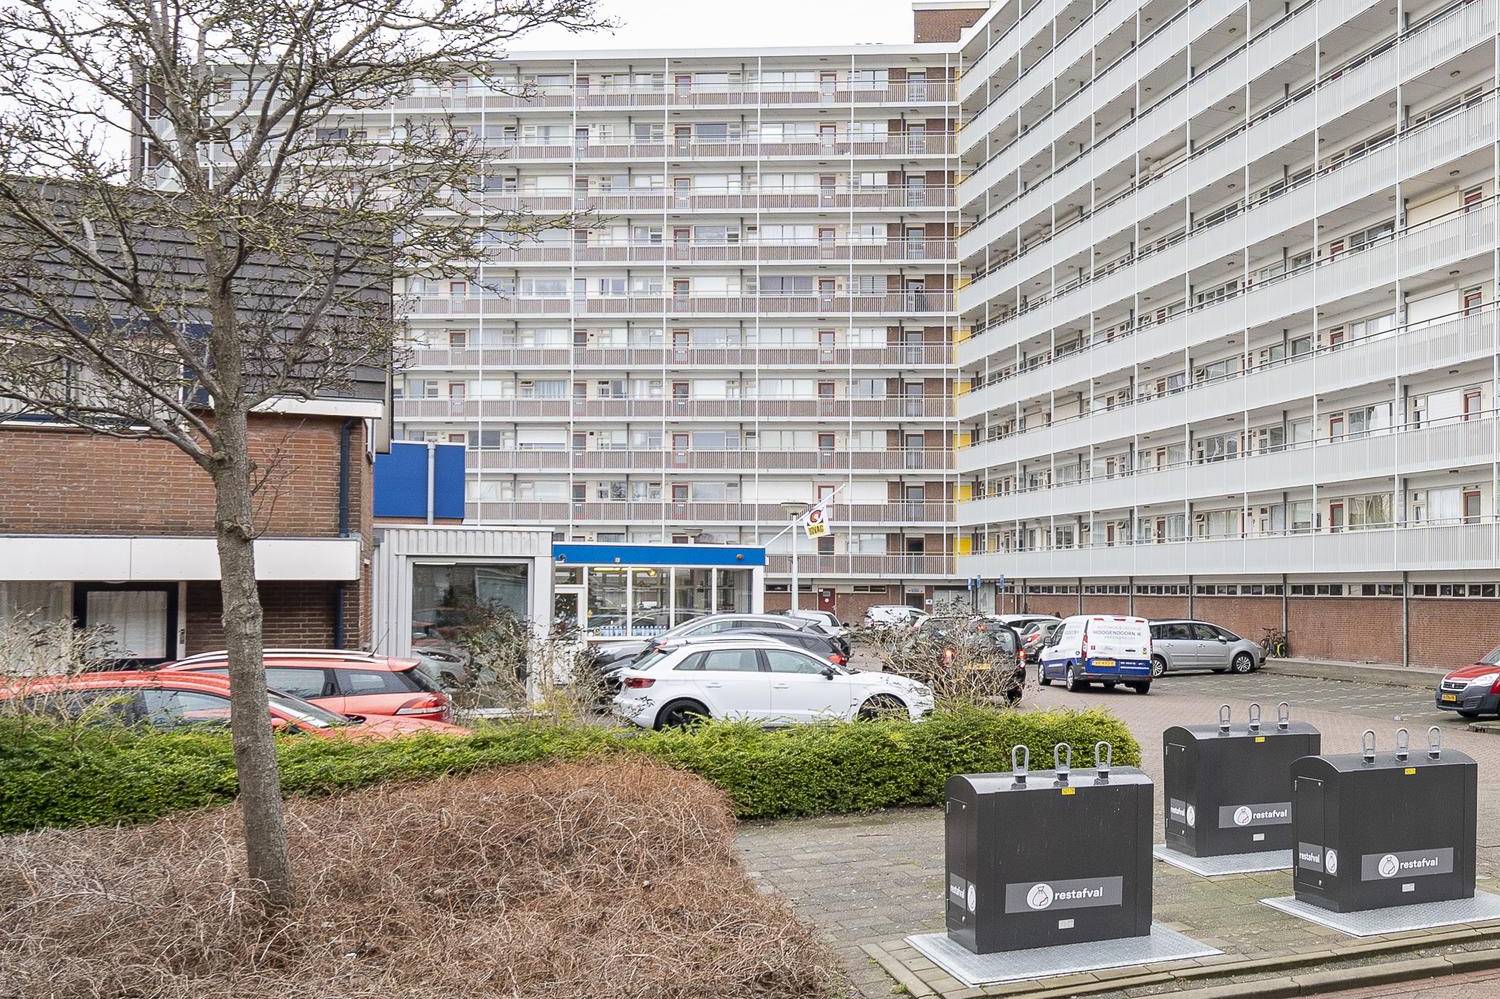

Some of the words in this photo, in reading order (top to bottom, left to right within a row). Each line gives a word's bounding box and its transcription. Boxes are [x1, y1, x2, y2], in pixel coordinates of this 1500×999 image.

[1253, 809, 1288, 819] restafval
[1299, 852, 1320, 864] restafval
[1400, 857, 1438, 869] restafval
[1054, 886, 1103, 900] restafval
